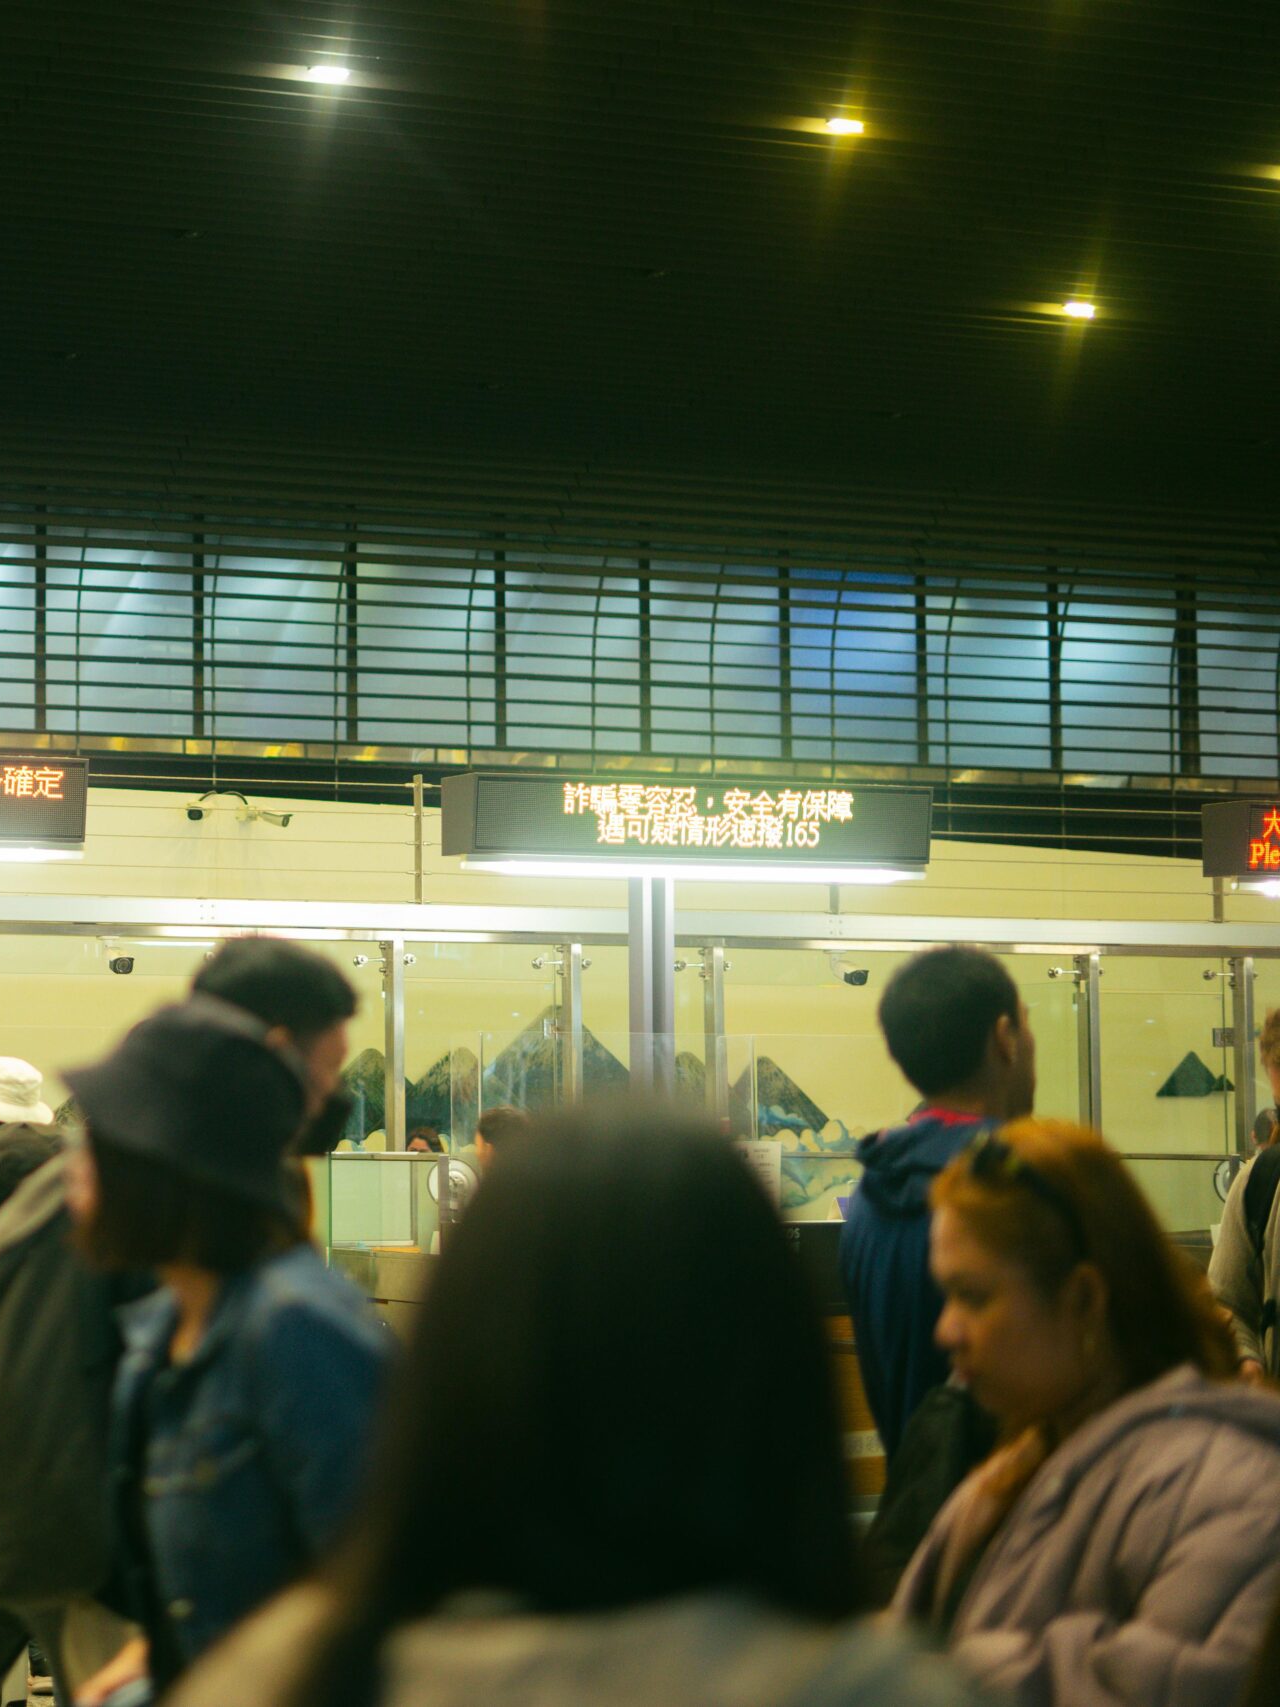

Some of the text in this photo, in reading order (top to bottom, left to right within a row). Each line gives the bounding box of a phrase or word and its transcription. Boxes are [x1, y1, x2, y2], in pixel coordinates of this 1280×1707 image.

[562, 782, 854, 823] 詐騙零容忍，安全有保障
